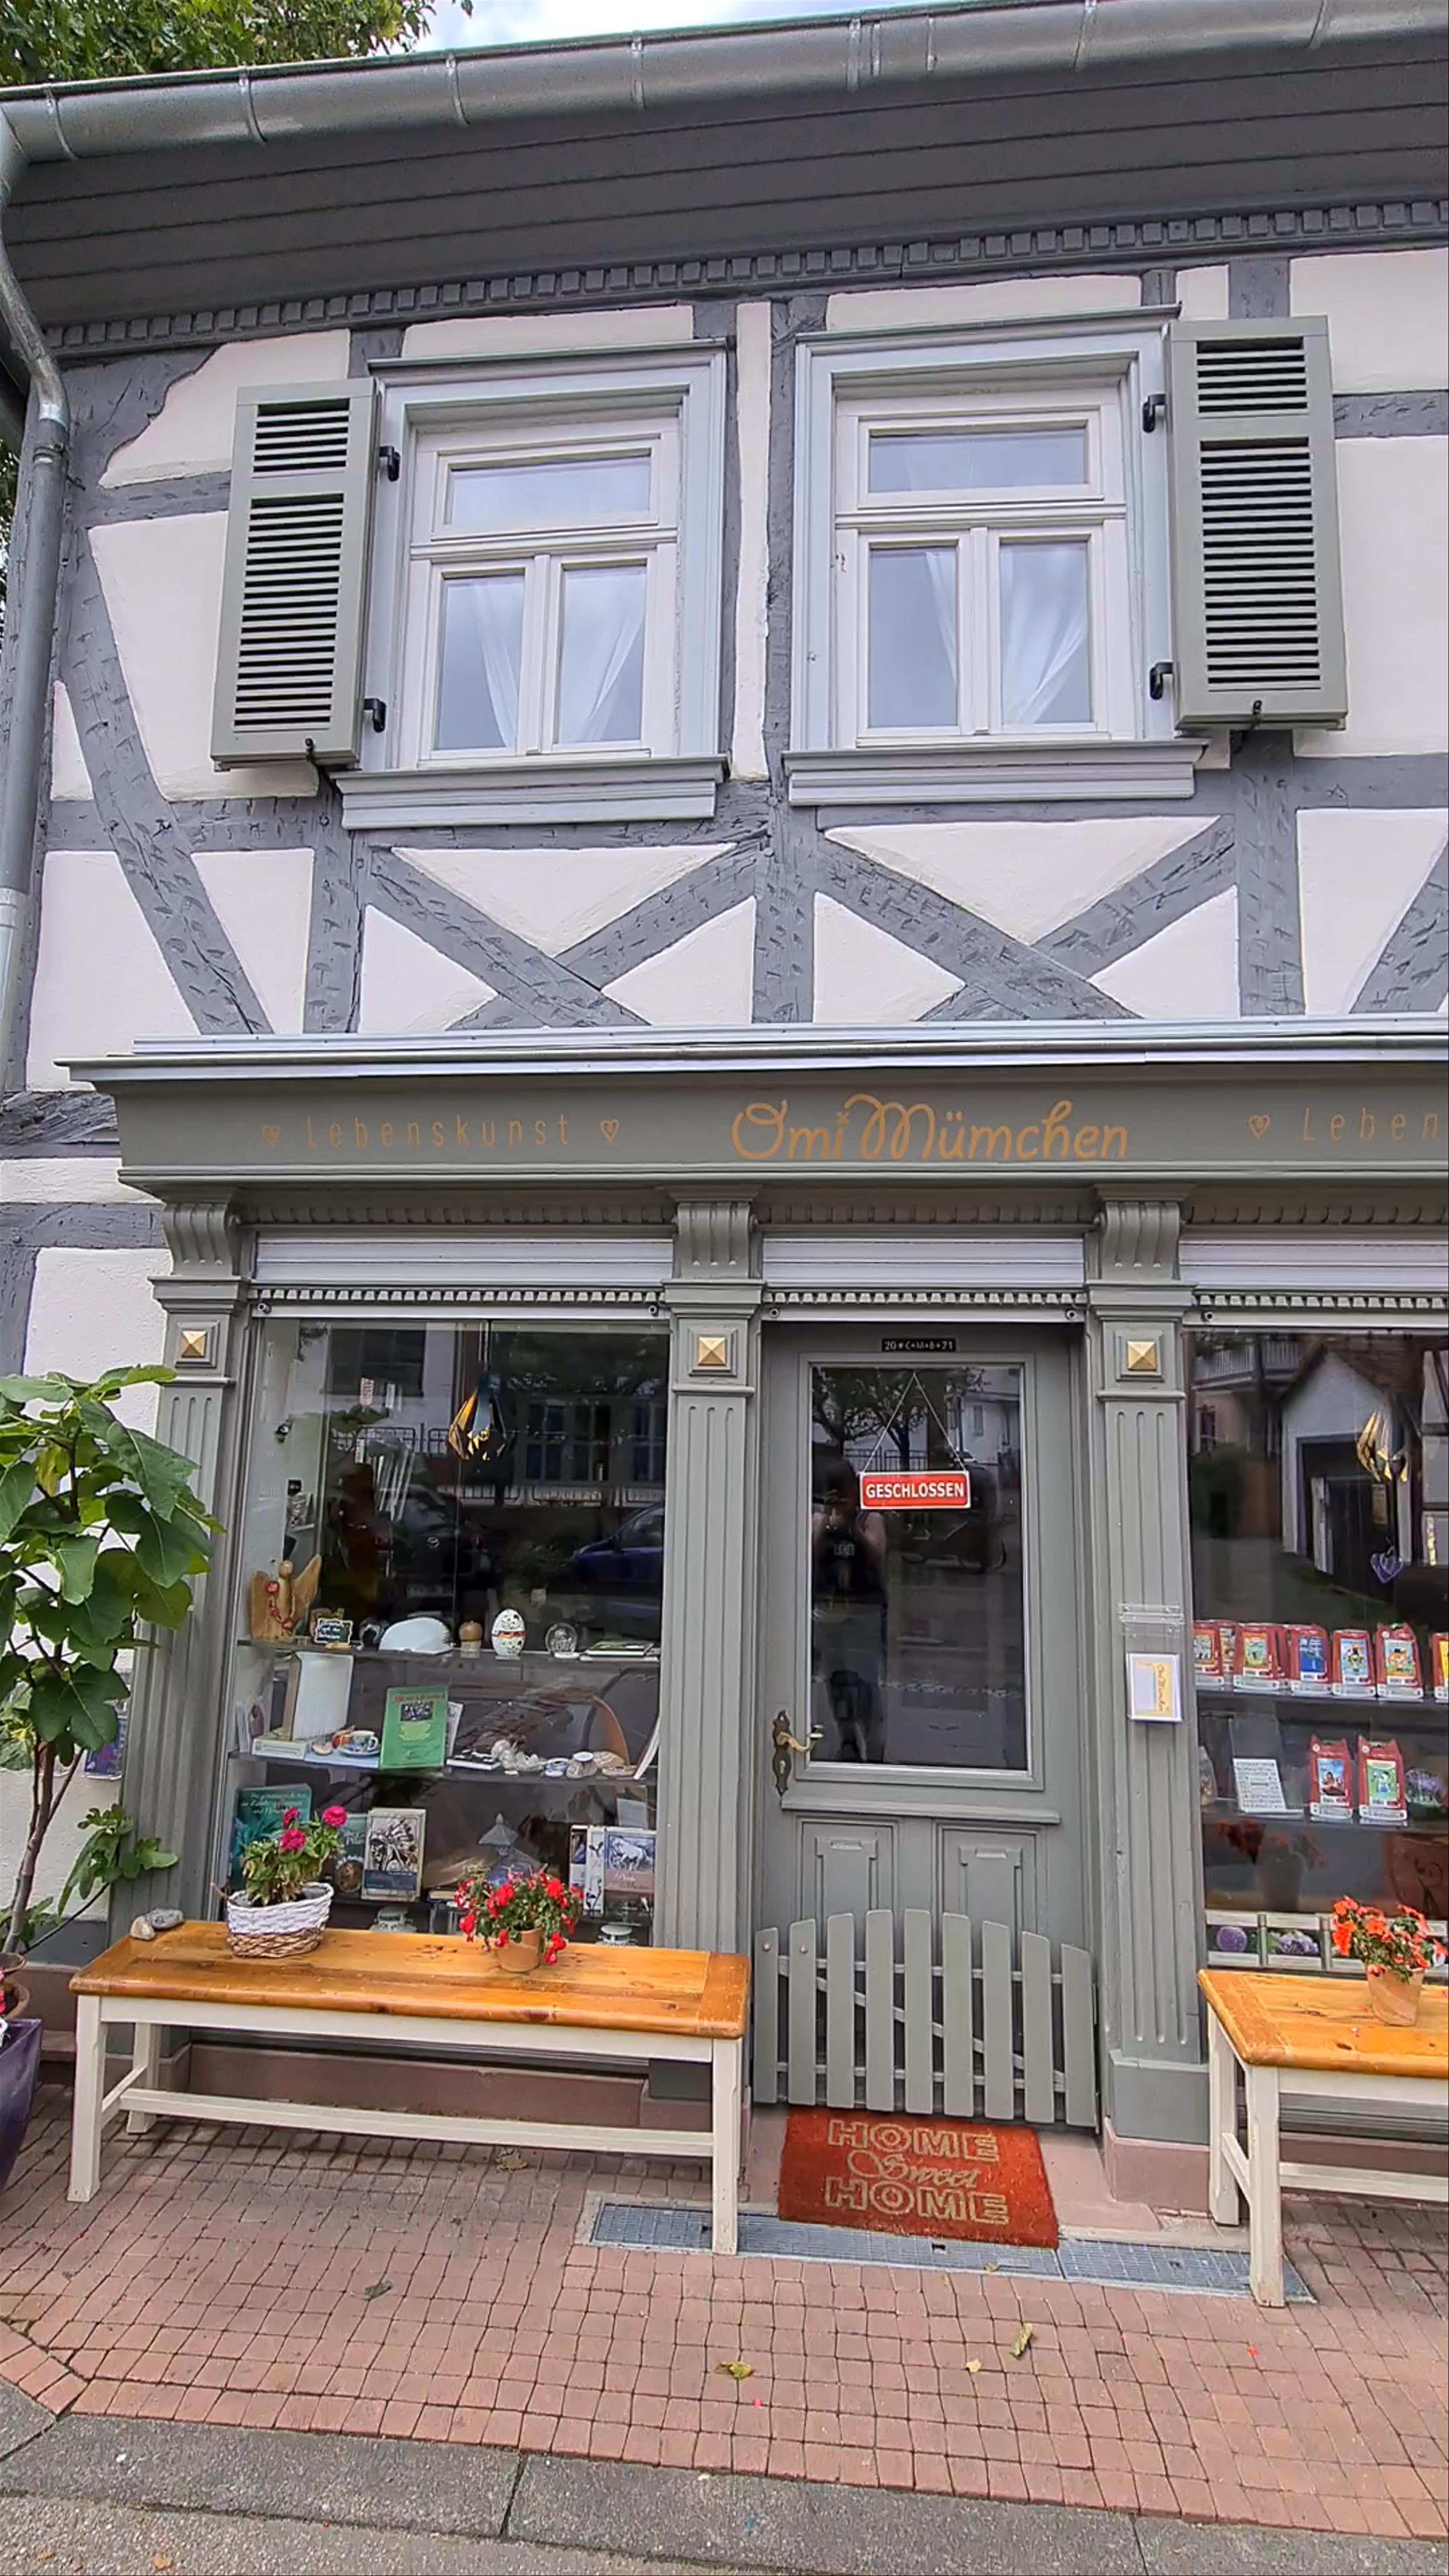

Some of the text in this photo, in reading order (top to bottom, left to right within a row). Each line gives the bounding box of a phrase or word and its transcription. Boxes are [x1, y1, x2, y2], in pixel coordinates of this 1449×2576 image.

[307, 1113, 569, 1149] Lebenskunst
[732, 1093, 1128, 1160] Omi Mümchen
[1303, 1107, 1440, 1141] Leben
[866, 1482, 964, 1498] GESCHLOSSEN
[828, 2119, 1000, 2162] HOME
[848, 2150, 981, 2188] Sweet
[824, 2176, 1009, 2225] HOME
